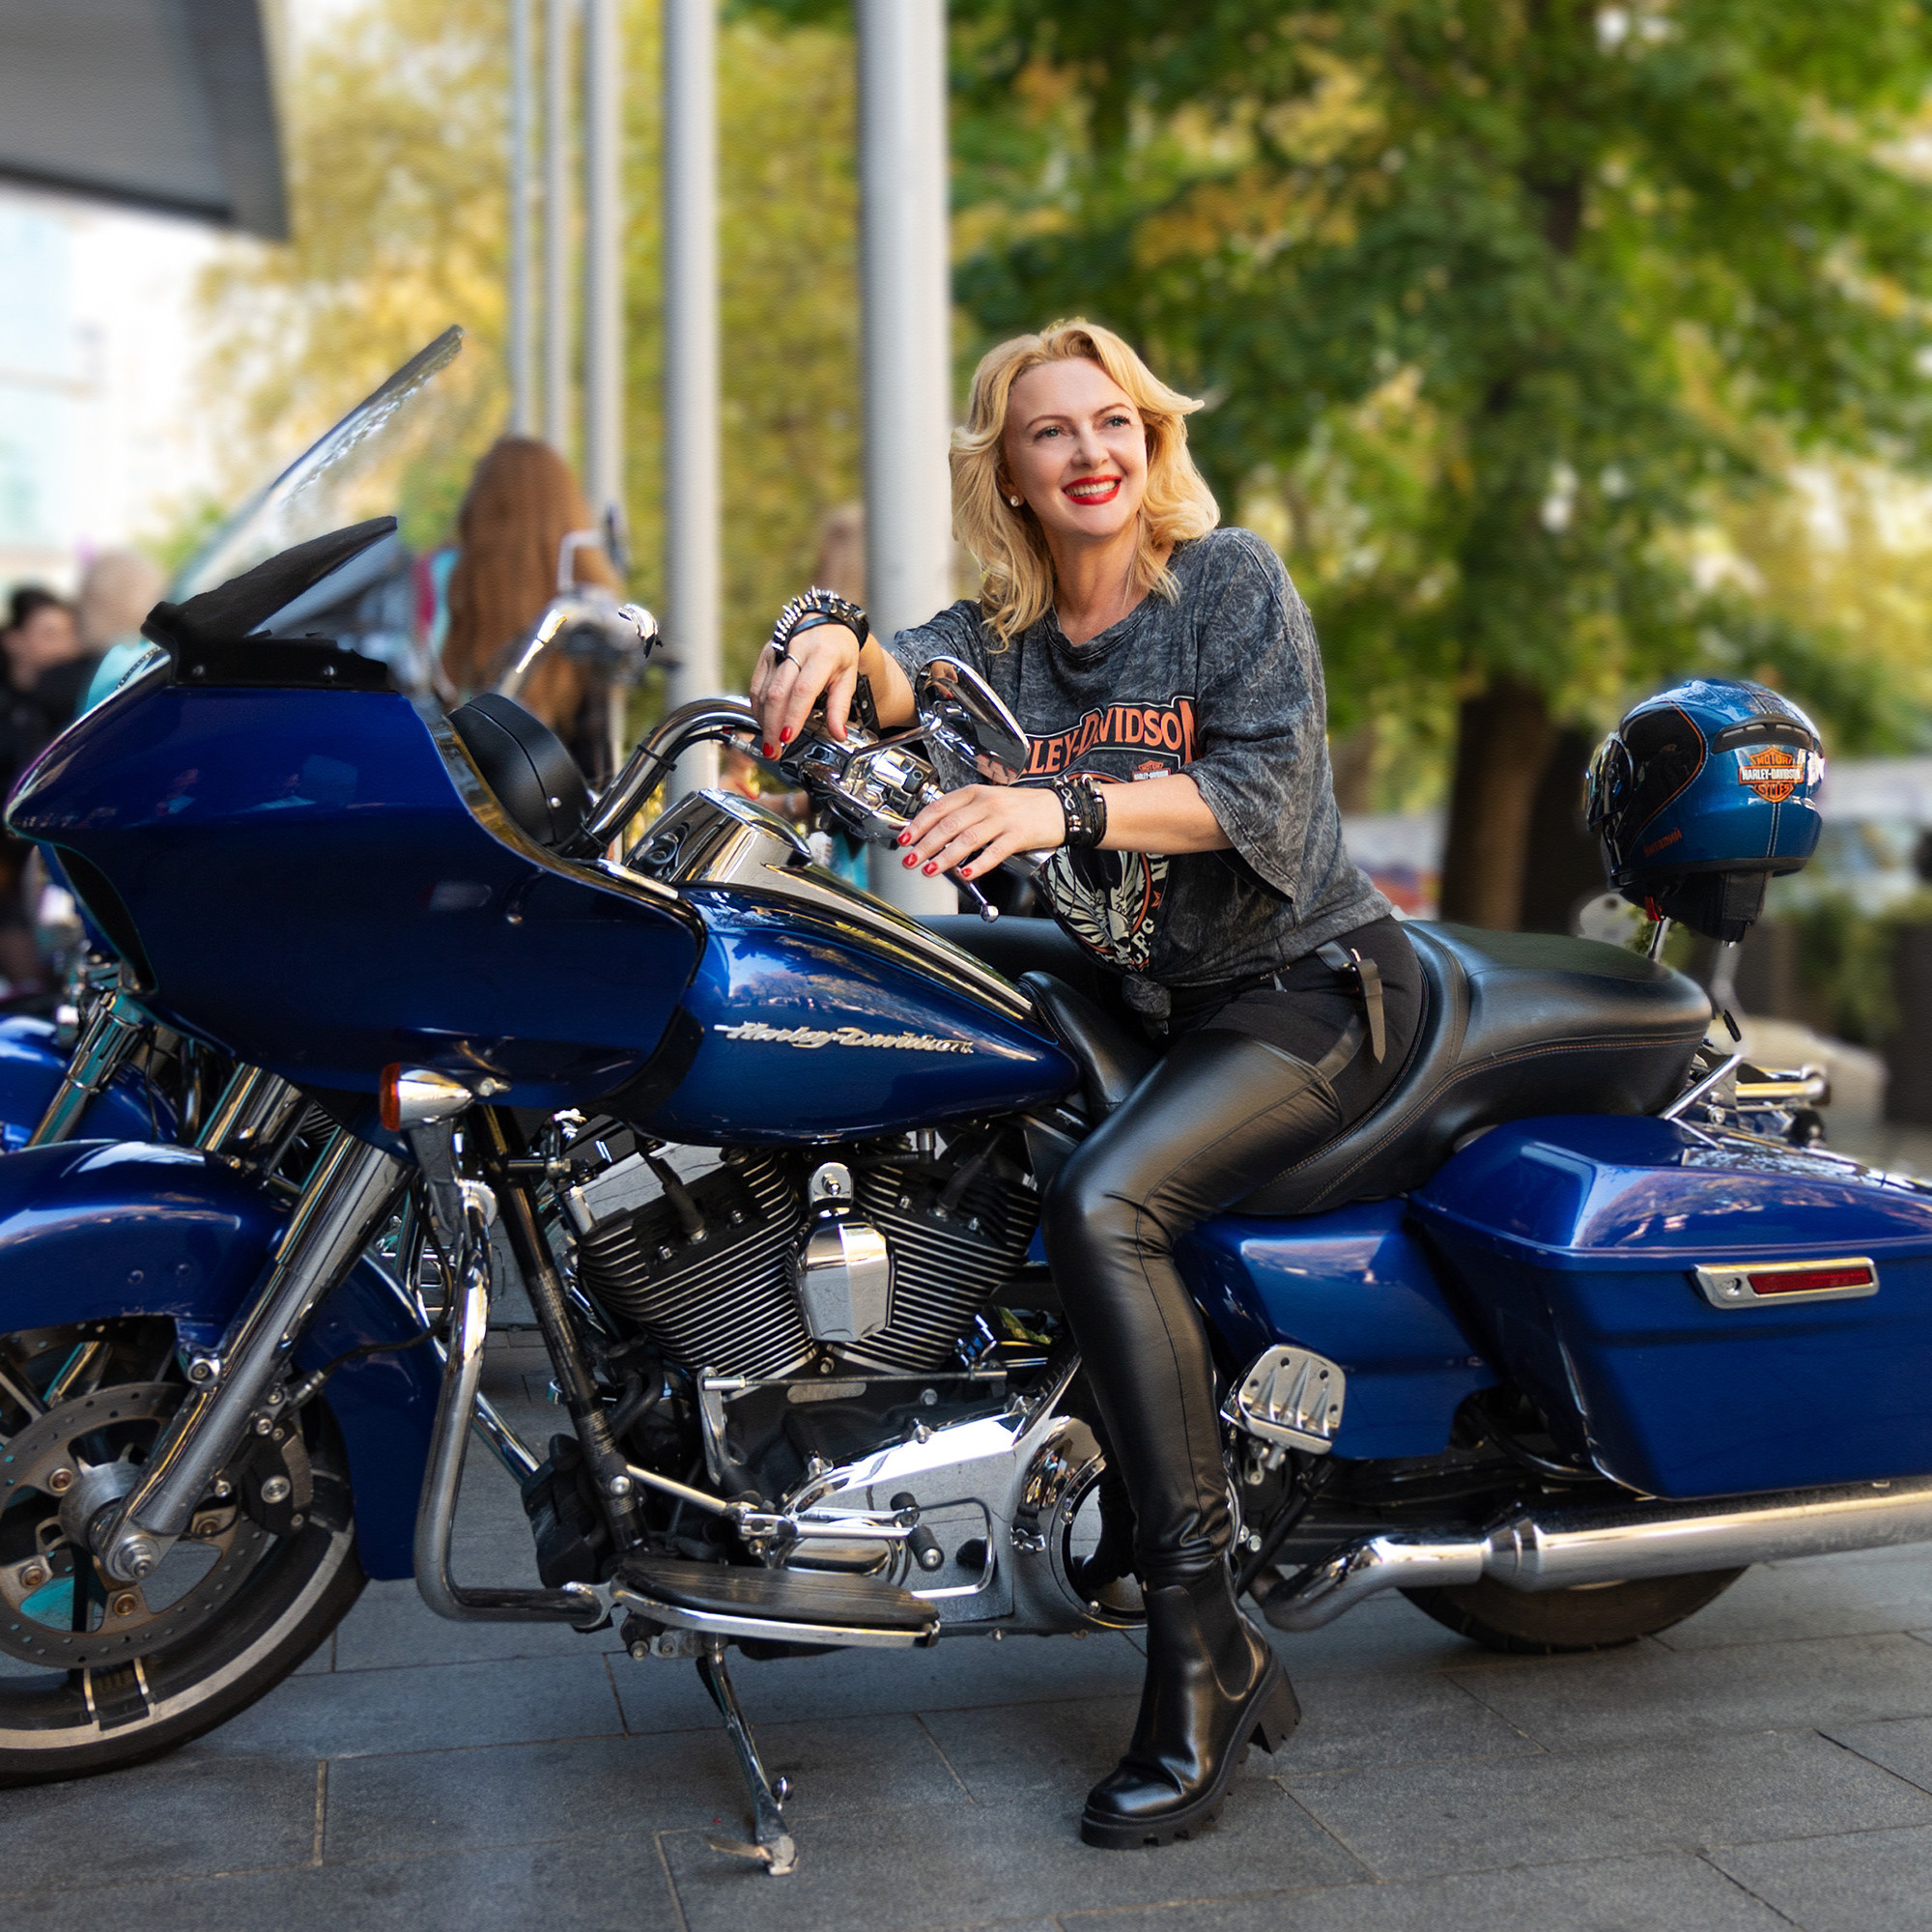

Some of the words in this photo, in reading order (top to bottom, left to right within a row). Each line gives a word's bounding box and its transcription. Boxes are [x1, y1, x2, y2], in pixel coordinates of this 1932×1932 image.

[1756, 752, 1789, 764] MOTOR
[1742, 768, 1801, 781] HARLEY-DAVIDSON
[1758, 783, 1790, 797] CYCLES
[713, 1020, 975, 1055] Harley-Davidson
